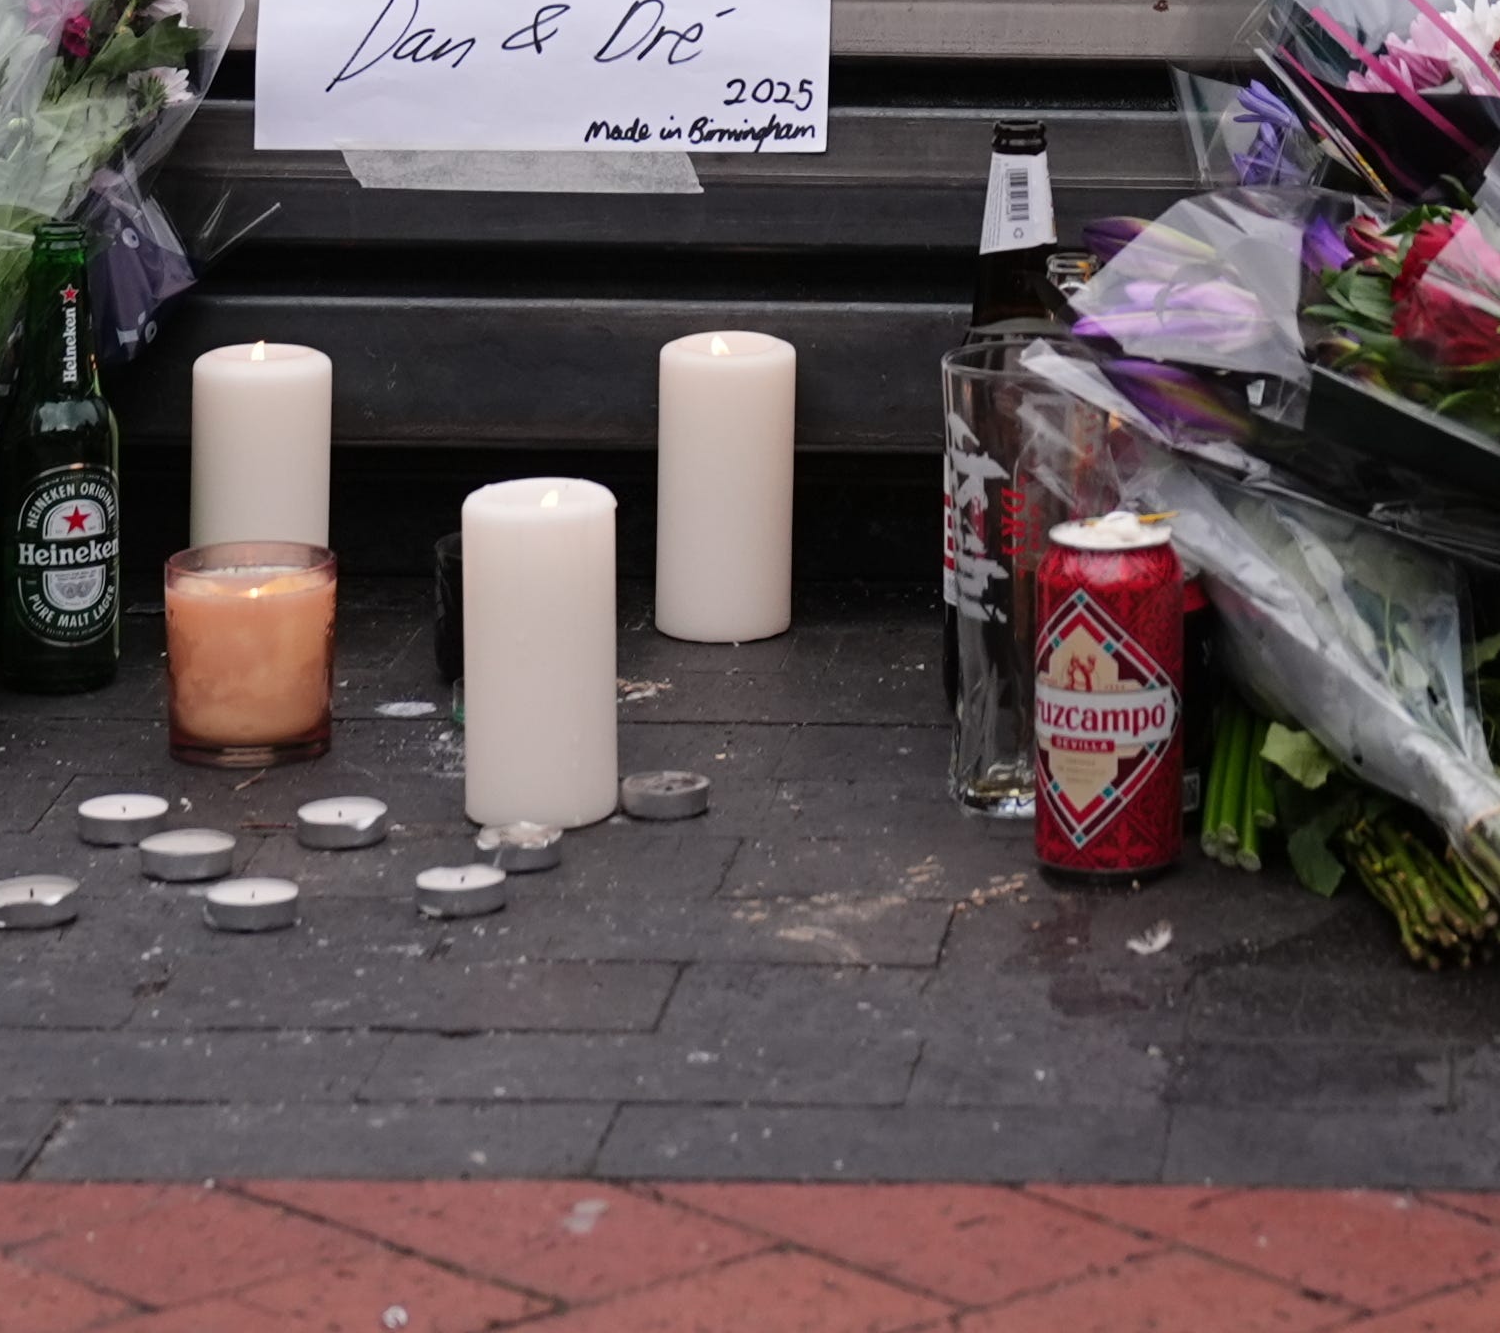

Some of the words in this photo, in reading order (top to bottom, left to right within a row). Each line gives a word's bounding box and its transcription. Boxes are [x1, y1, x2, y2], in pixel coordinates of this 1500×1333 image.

[501, 4, 572, 54] &
[723, 77, 814, 111] 2025
[585, 119, 651, 144] Made
[660, 116, 683, 142] in
[687, 114, 817, 154] Birmingham
[62, 306, 78, 383] Heineken
[26, 485, 76, 529] HEINEKEN
[79, 482, 117, 520] ORIGINAL
[18, 534, 119, 567] Heineken
[28, 592, 56, 627] PURE
[57, 608, 92, 628] MALT
[93, 584, 116, 623] LAGER
[1035, 698, 1167, 737] ruzcampo
[1055, 737, 1110, 753] SEVILLA
